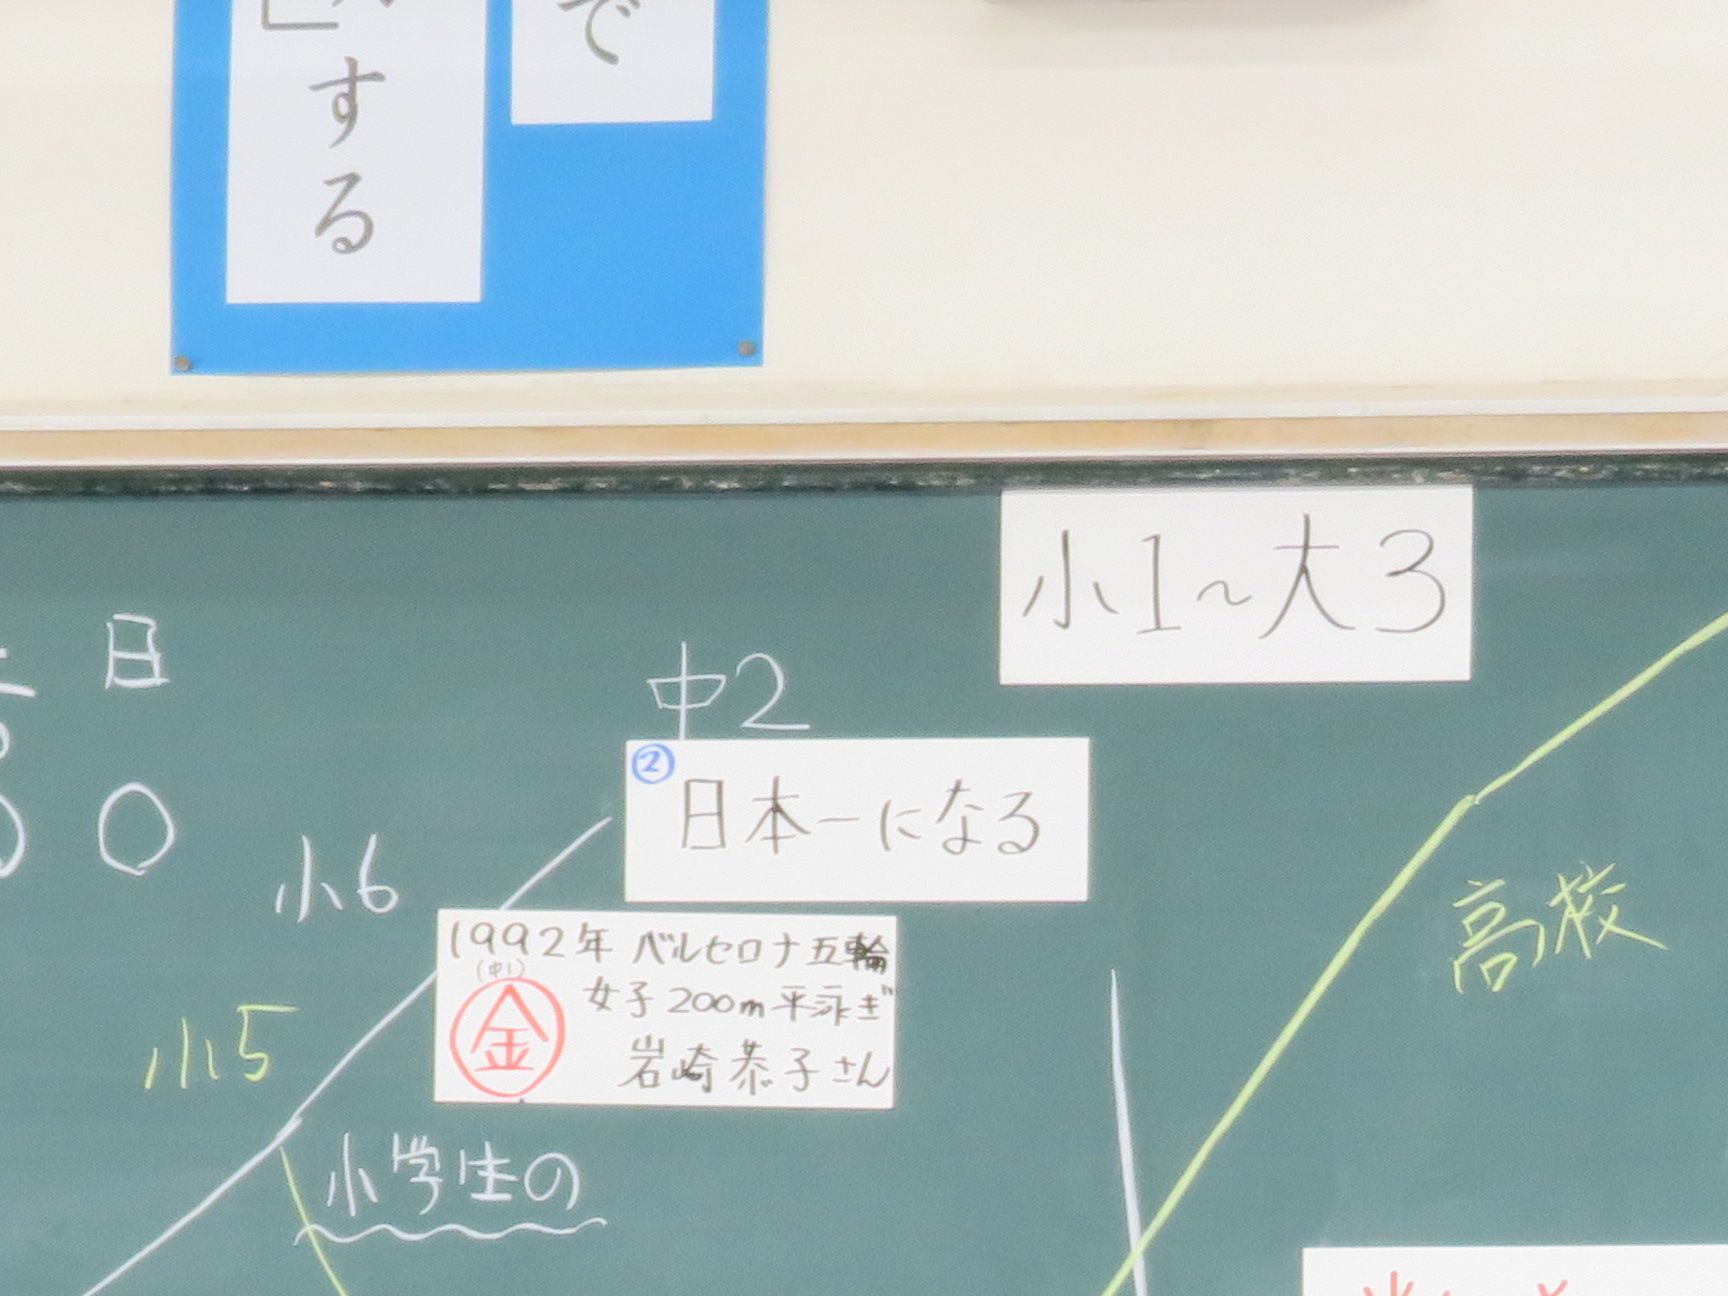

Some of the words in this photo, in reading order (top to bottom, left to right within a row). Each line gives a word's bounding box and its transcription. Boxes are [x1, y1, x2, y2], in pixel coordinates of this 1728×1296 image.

[261, 0, 386, 255] する
[104, 612, 170, 690] 日
[647, 642, 809, 740] 中2
[679, 775, 1042, 856] 日本一になる
[276, 834, 398, 922] 小6
[451, 921, 613, 963] 1992年
[1451, 860, 1668, 995] 高校
[326, 1132, 581, 1216] 小学生の
